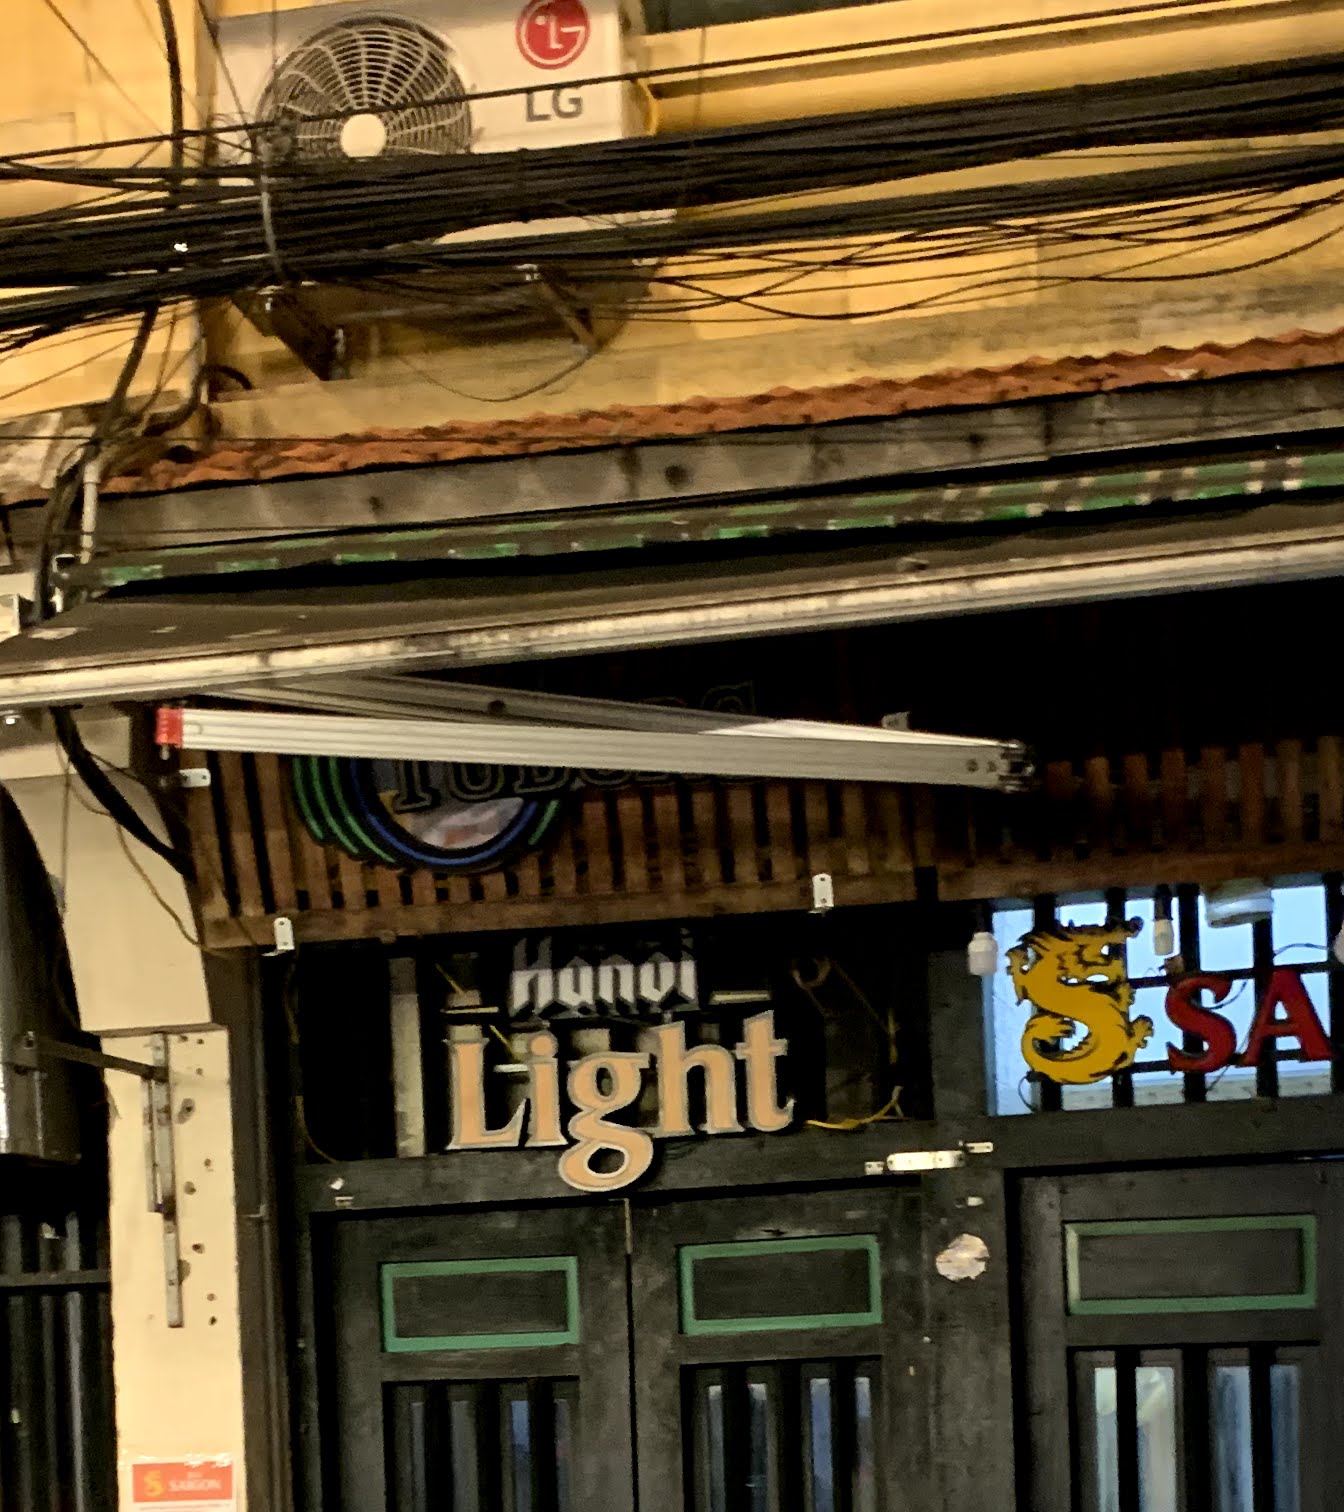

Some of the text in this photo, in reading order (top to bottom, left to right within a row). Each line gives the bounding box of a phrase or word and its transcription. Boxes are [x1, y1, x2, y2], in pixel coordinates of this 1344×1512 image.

[525, 84, 583, 122] LG
[510, 928, 698, 1016] Hanoi
[443, 1009, 795, 1192] Light
